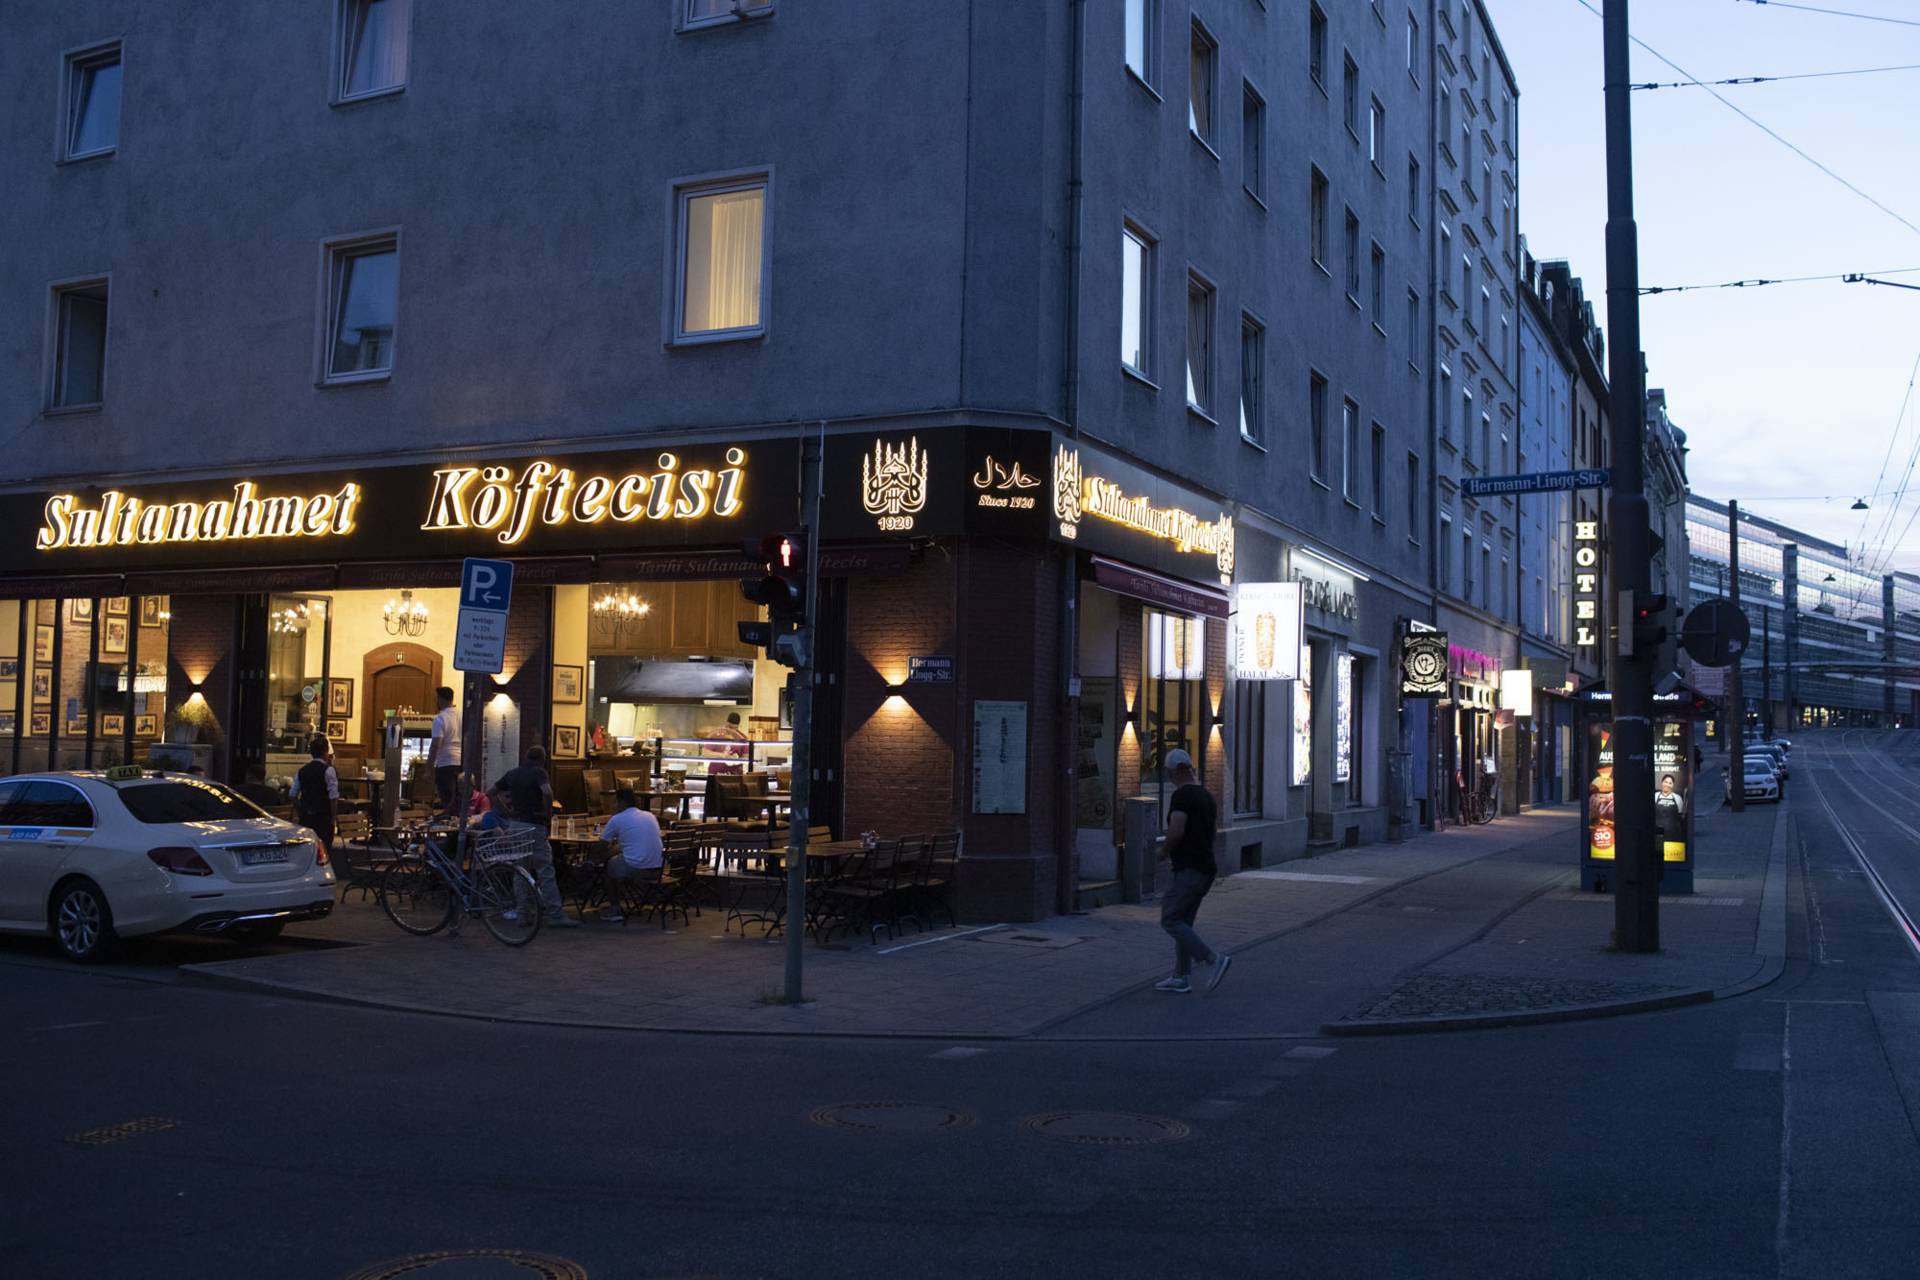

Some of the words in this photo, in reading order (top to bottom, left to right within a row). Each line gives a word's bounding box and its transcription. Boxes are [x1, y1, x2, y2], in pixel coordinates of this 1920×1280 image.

[1469, 471, 1603, 494] Hermann-Lingg-Str.
[36, 481, 362, 550] Sultanahmet
[420, 447, 745, 544] Köftecisi
[978, 495, 1008, 508] Since
[1009, 496, 1034, 509] 1920
[877, 516, 914, 531] 1920
[1575, 521, 1597, 645] HOTEL
